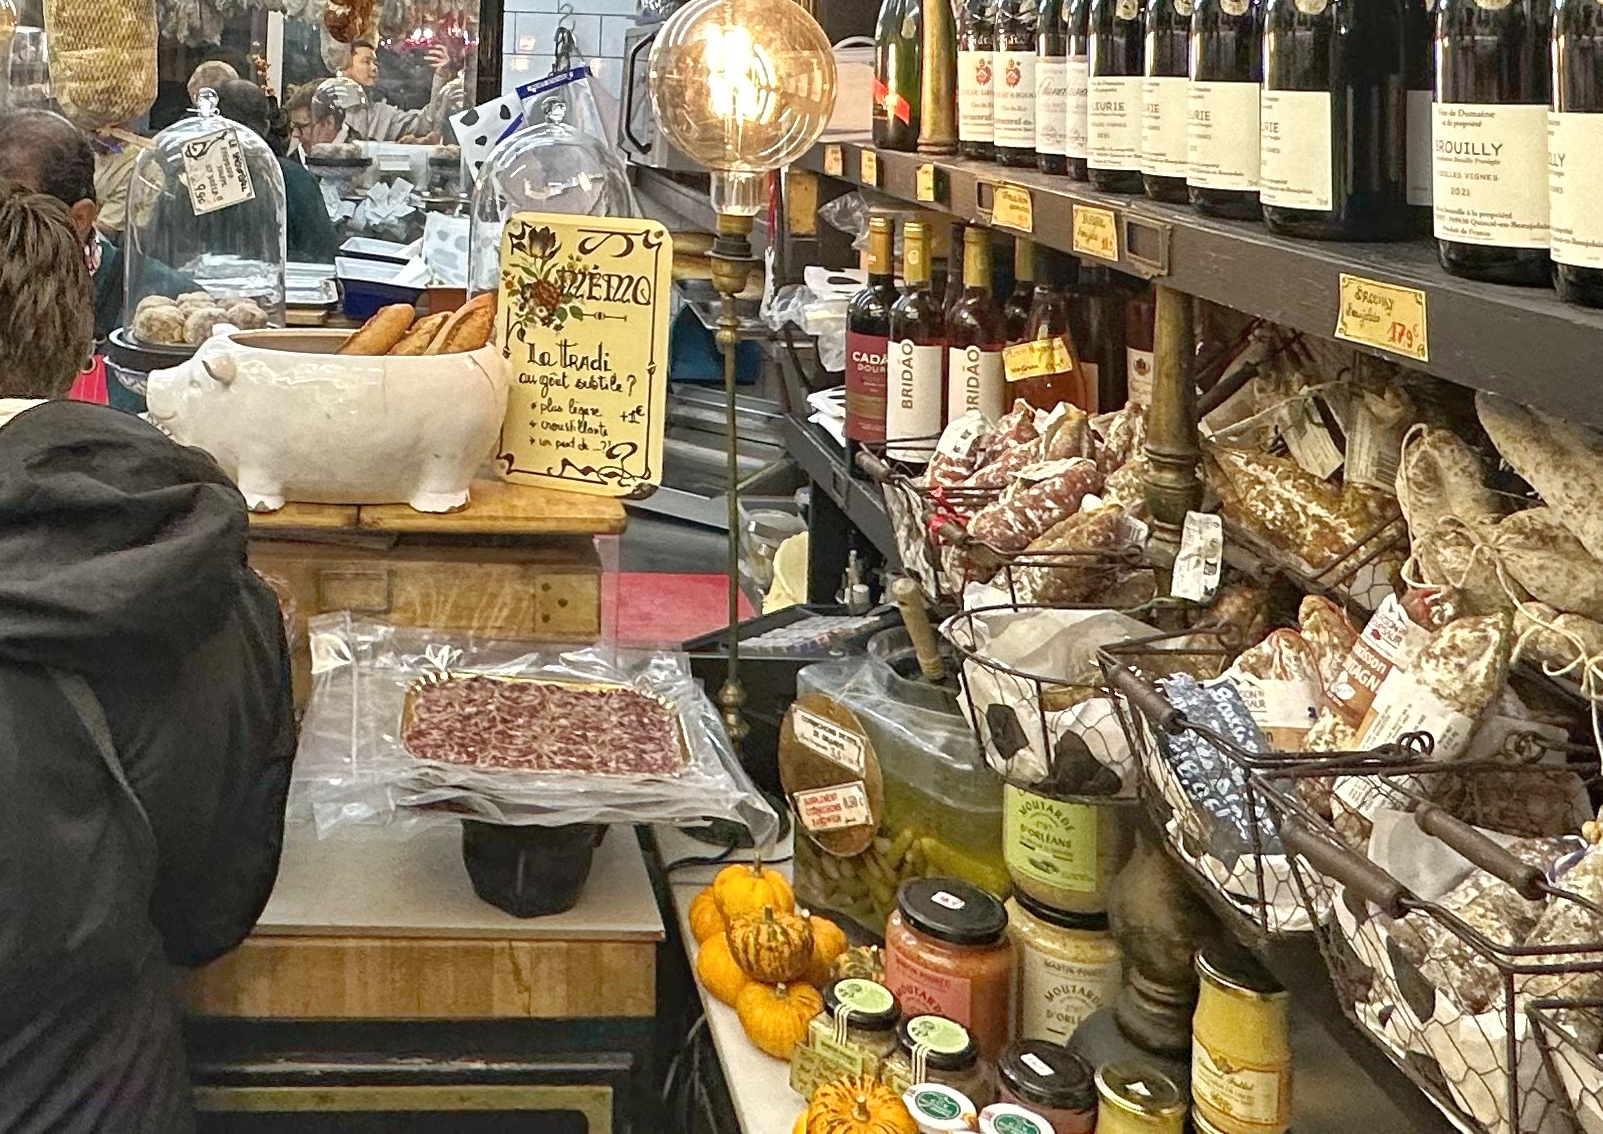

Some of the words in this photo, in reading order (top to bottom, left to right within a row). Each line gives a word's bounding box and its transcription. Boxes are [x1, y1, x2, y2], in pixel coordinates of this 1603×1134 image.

[556, 265, 653, 306] MÉMO
[518, 372, 538, 386] au
[857, 363, 886, 374] DOUR
[897, 342, 914, 409] BRIDÃO
[539, 397, 563, 415] plus
[1018, 799, 1076, 834] MOUTARDE
[895, 984, 943, 1013] MOUTARD
